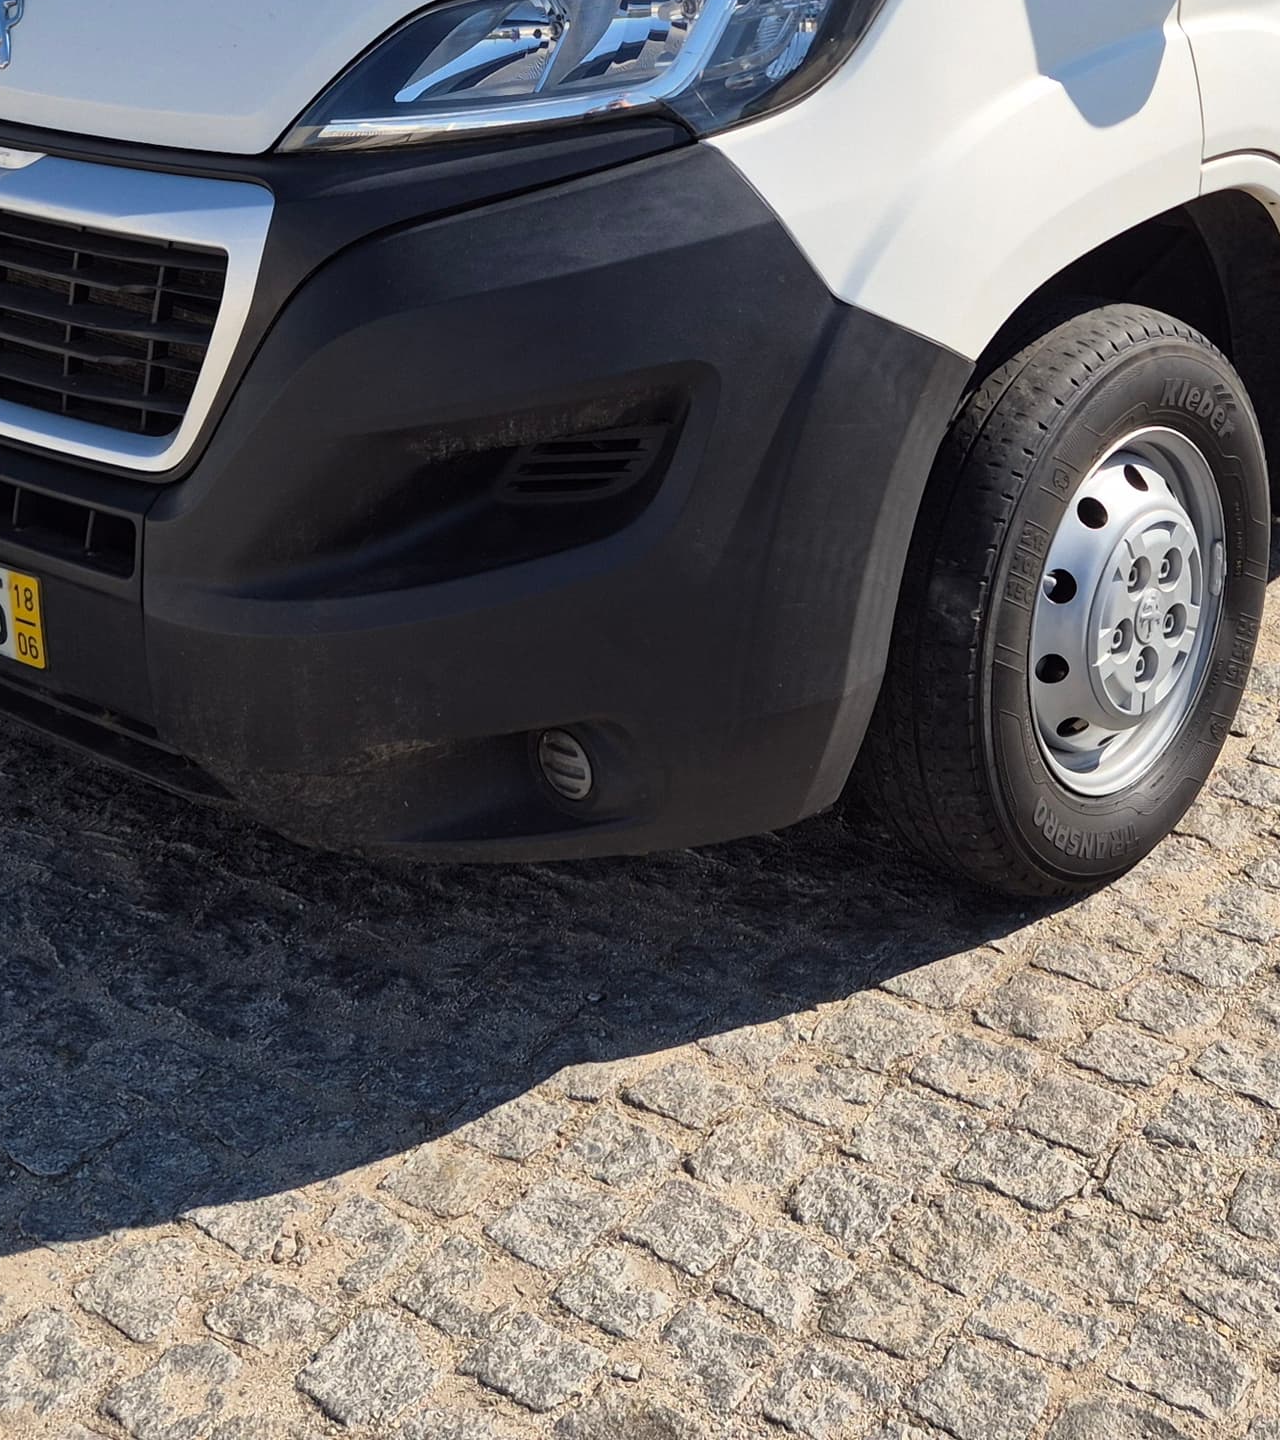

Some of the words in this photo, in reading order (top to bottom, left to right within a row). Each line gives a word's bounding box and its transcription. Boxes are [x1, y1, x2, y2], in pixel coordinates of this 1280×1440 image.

[14, 584, 34, 611] 18
[18, 631, 39, 660] 06
[1033, 797, 1140, 859] TRANSPRO
